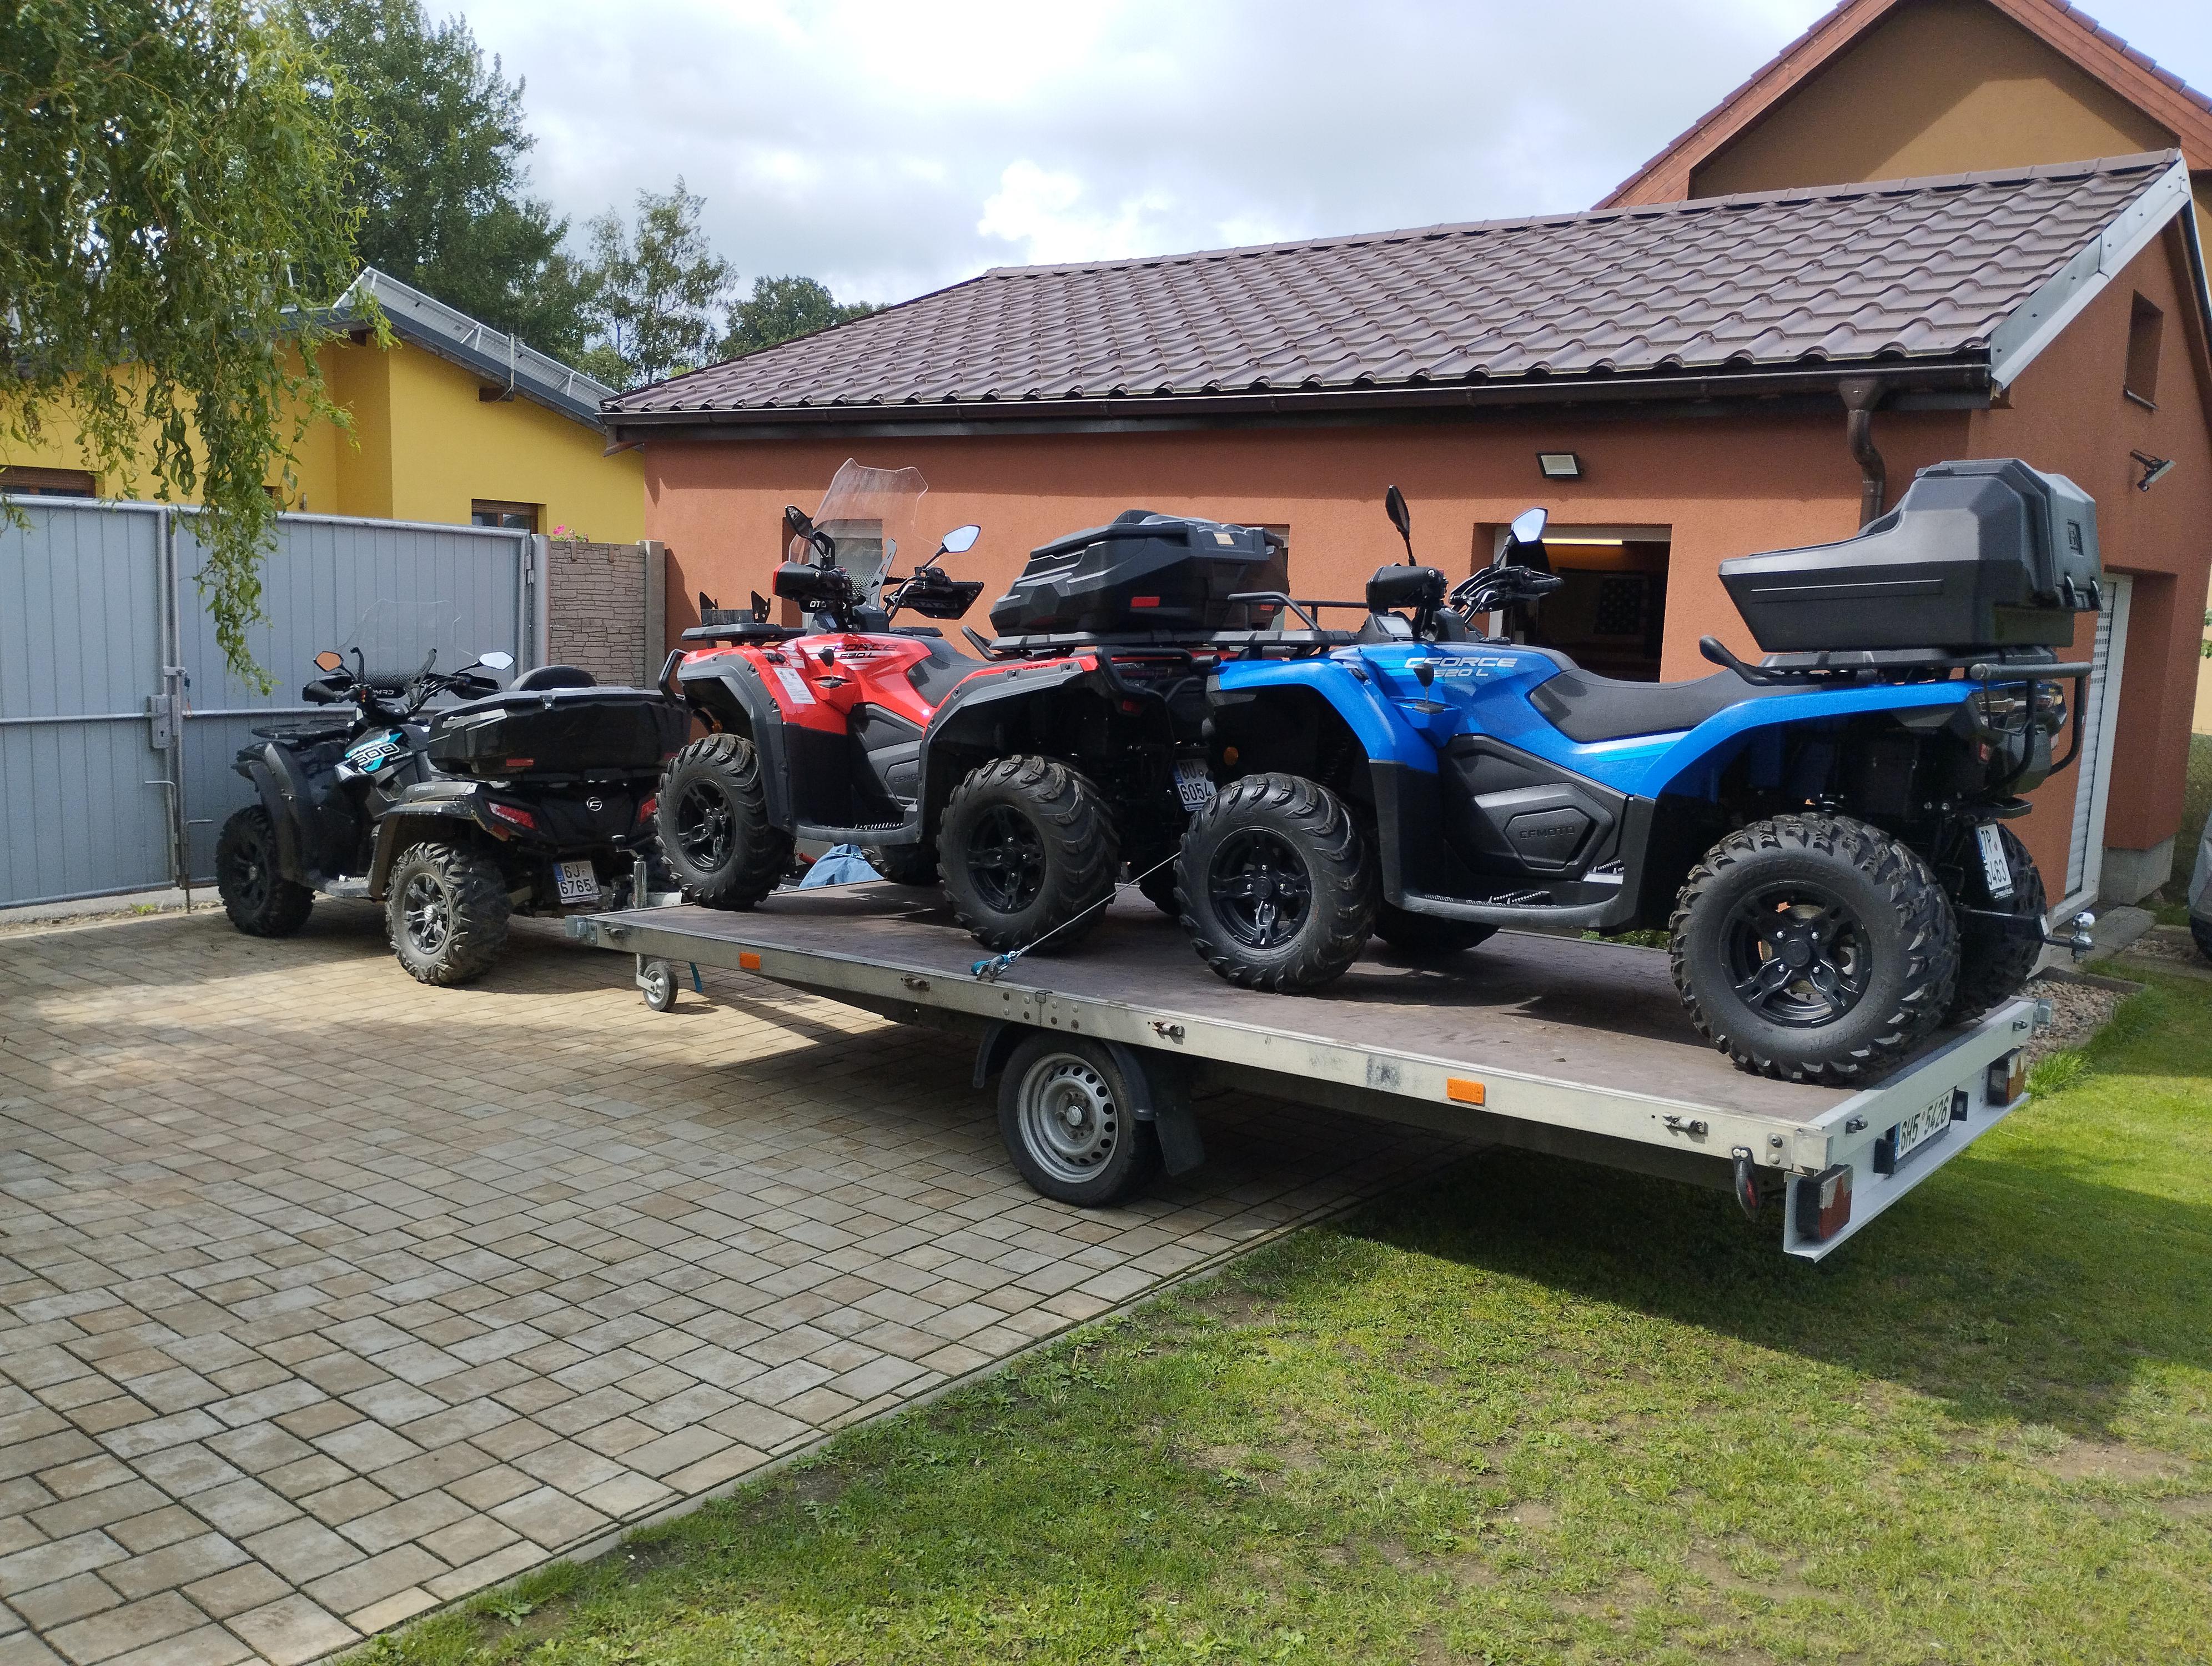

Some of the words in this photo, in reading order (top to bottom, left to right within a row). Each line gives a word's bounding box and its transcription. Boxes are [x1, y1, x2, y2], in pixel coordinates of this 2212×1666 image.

[1404, 657, 1518, 668] CFORCE
[1434, 668, 1472, 678] 520
[1475, 668, 1489, 677] L
[1180, 782, 1213, 801] 6054
[1520, 826, 1575, 840] CFMOTO
[1980, 830, 1993, 855] 7P
[564, 864, 581, 879] 6J
[560, 879, 592, 895] 6765
[1901, 1112, 1921, 1152] 6H5
[1923, 1095, 1949, 1136] 5426
